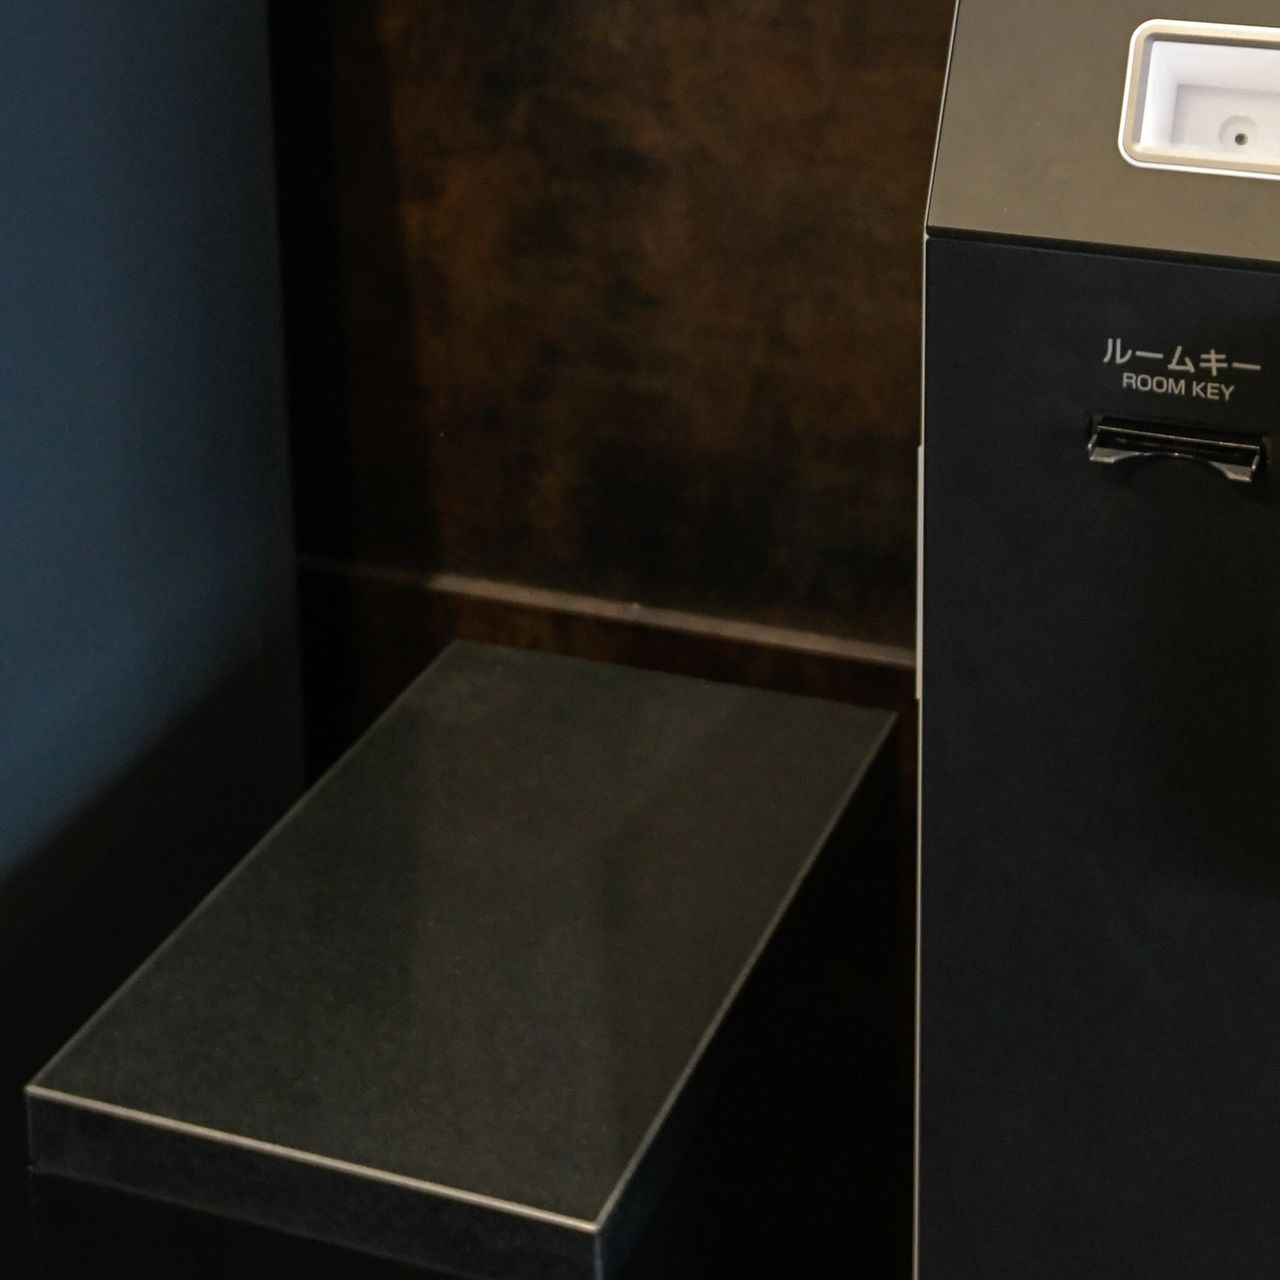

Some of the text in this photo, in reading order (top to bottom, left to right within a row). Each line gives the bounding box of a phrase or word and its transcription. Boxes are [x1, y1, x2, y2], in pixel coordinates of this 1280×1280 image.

[1102, 338, 1262, 377] ルームキー
[1122, 371, 1235, 401] ROOM KEY
